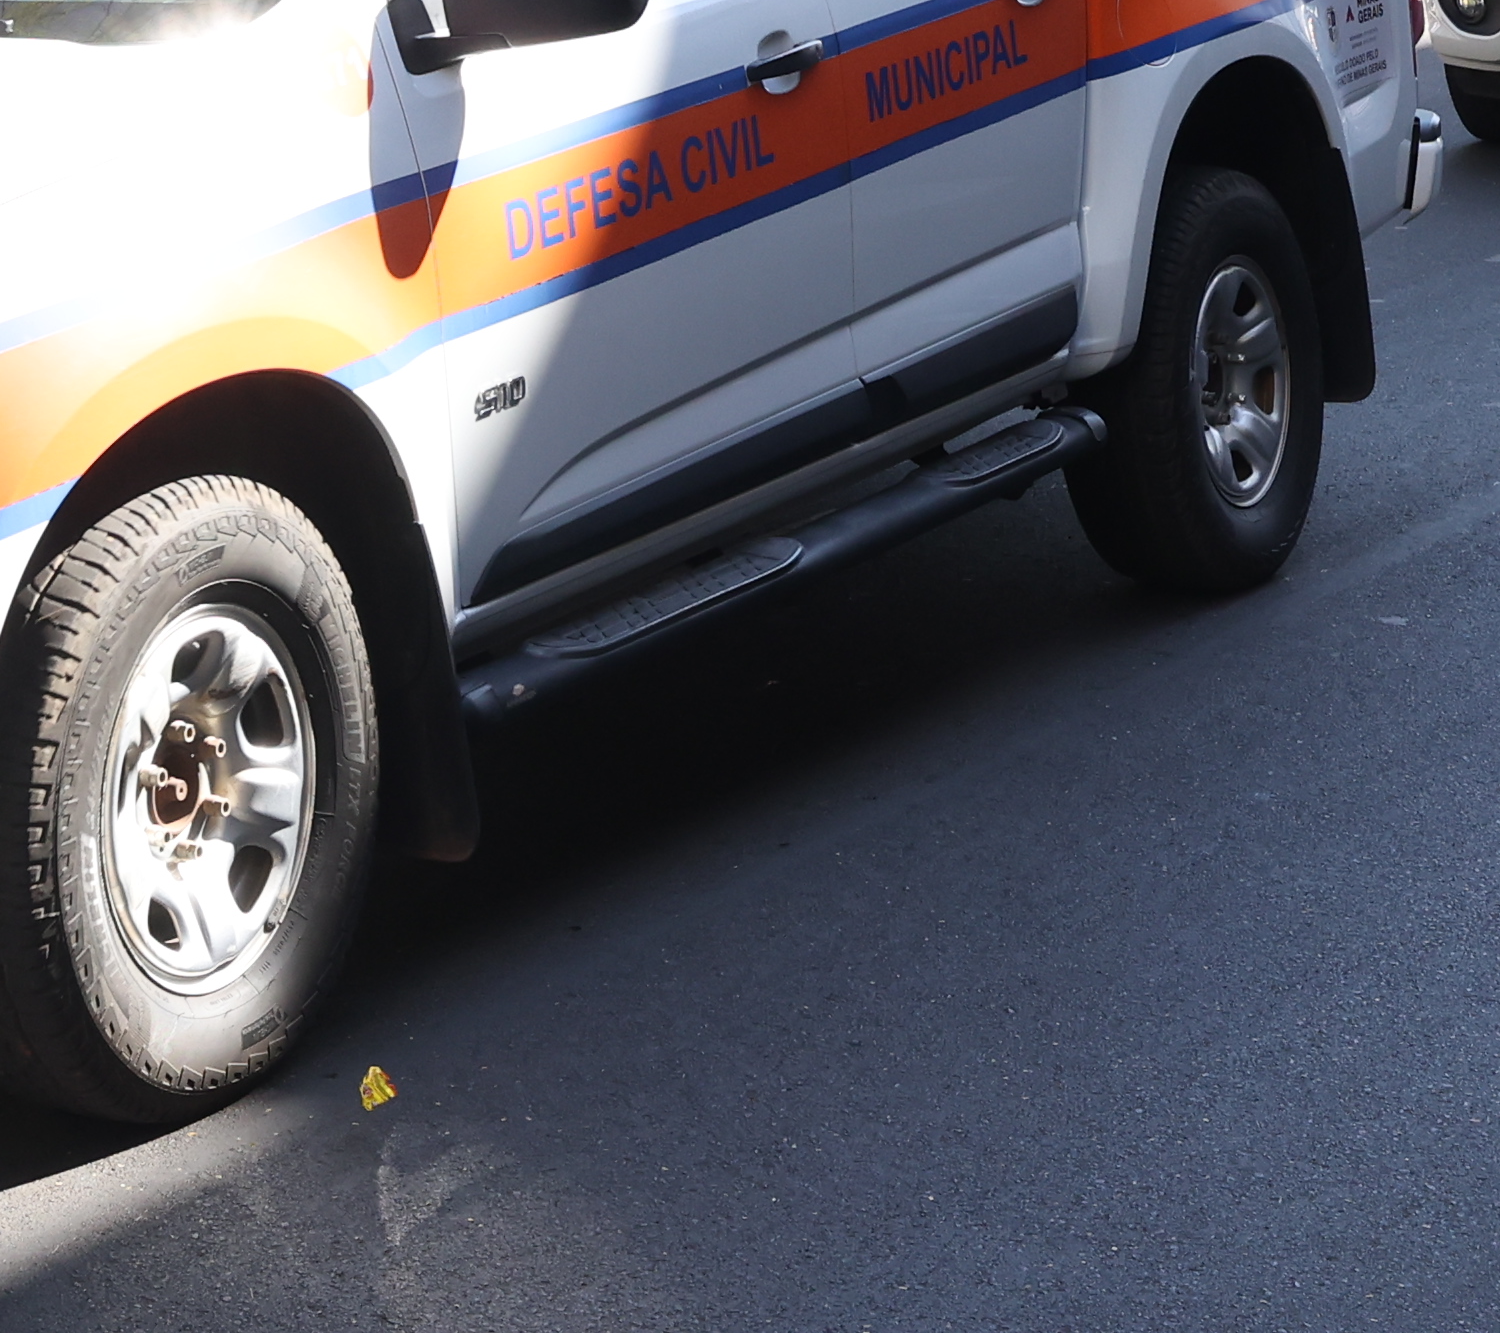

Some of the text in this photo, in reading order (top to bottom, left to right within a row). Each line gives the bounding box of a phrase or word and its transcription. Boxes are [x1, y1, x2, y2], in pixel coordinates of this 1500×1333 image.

[1358, 3, 1384, 24] GERAIS
[864, 19, 1028, 123] MUNICIPAL
[503, 115, 775, 261] DEFESA CIVIL
